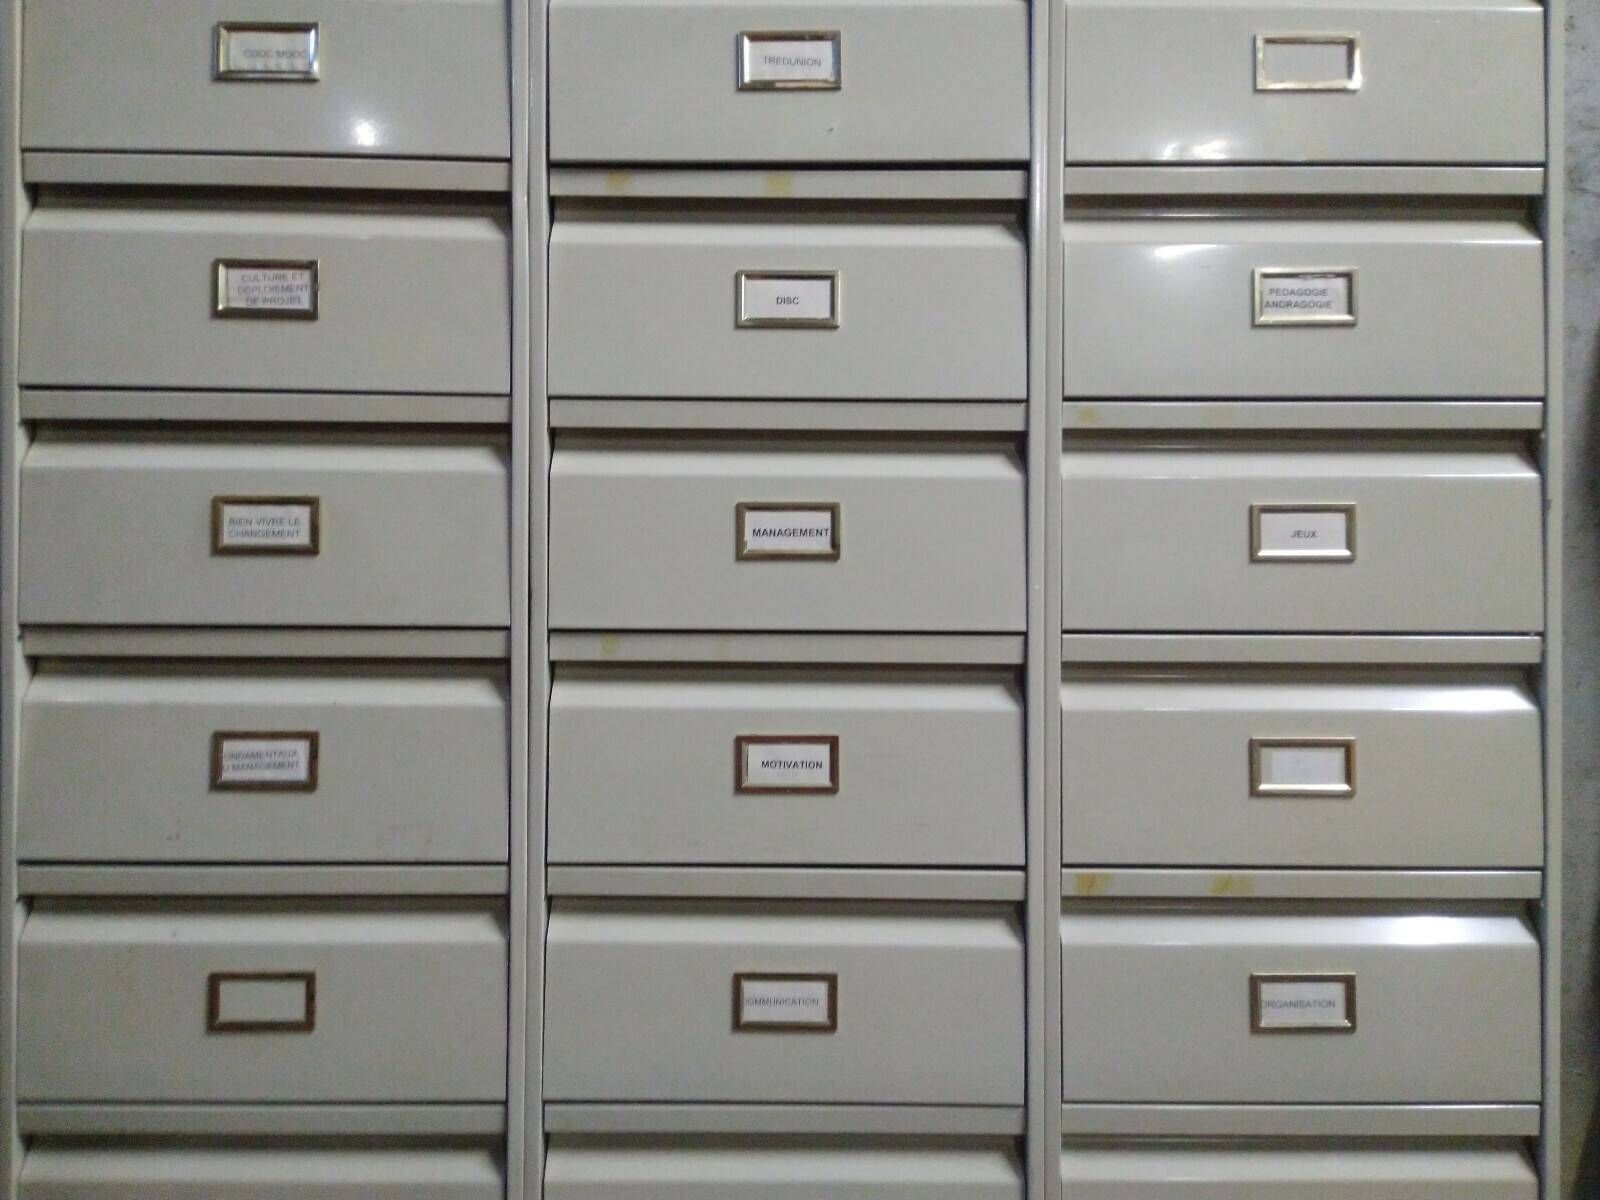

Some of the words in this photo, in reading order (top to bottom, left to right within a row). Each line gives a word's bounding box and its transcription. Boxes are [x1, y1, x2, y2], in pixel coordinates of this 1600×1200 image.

[241, 272, 288, 282] CULTURE
[291, 271, 305, 281] ET
[1268, 288, 1328, 297] PEDAGOGIE
[776, 296, 800, 305] DISC
[1263, 300, 1333, 309] ANDRAGOGIE
[229, 518, 253, 527] BIEN
[256, 518, 285, 527] VIVRE
[288, 518, 301, 527] LE
[228, 528, 301, 538] CHANGEMENT
[752, 528, 829, 538] MANAGEMENT
[1290, 530, 1318, 539] JEUX
[761, 760, 823, 769] MOTIVATION
[745, 997, 820, 1007] OMMUNICATION
[1261, 999, 1336, 1009] ORGANISATION
